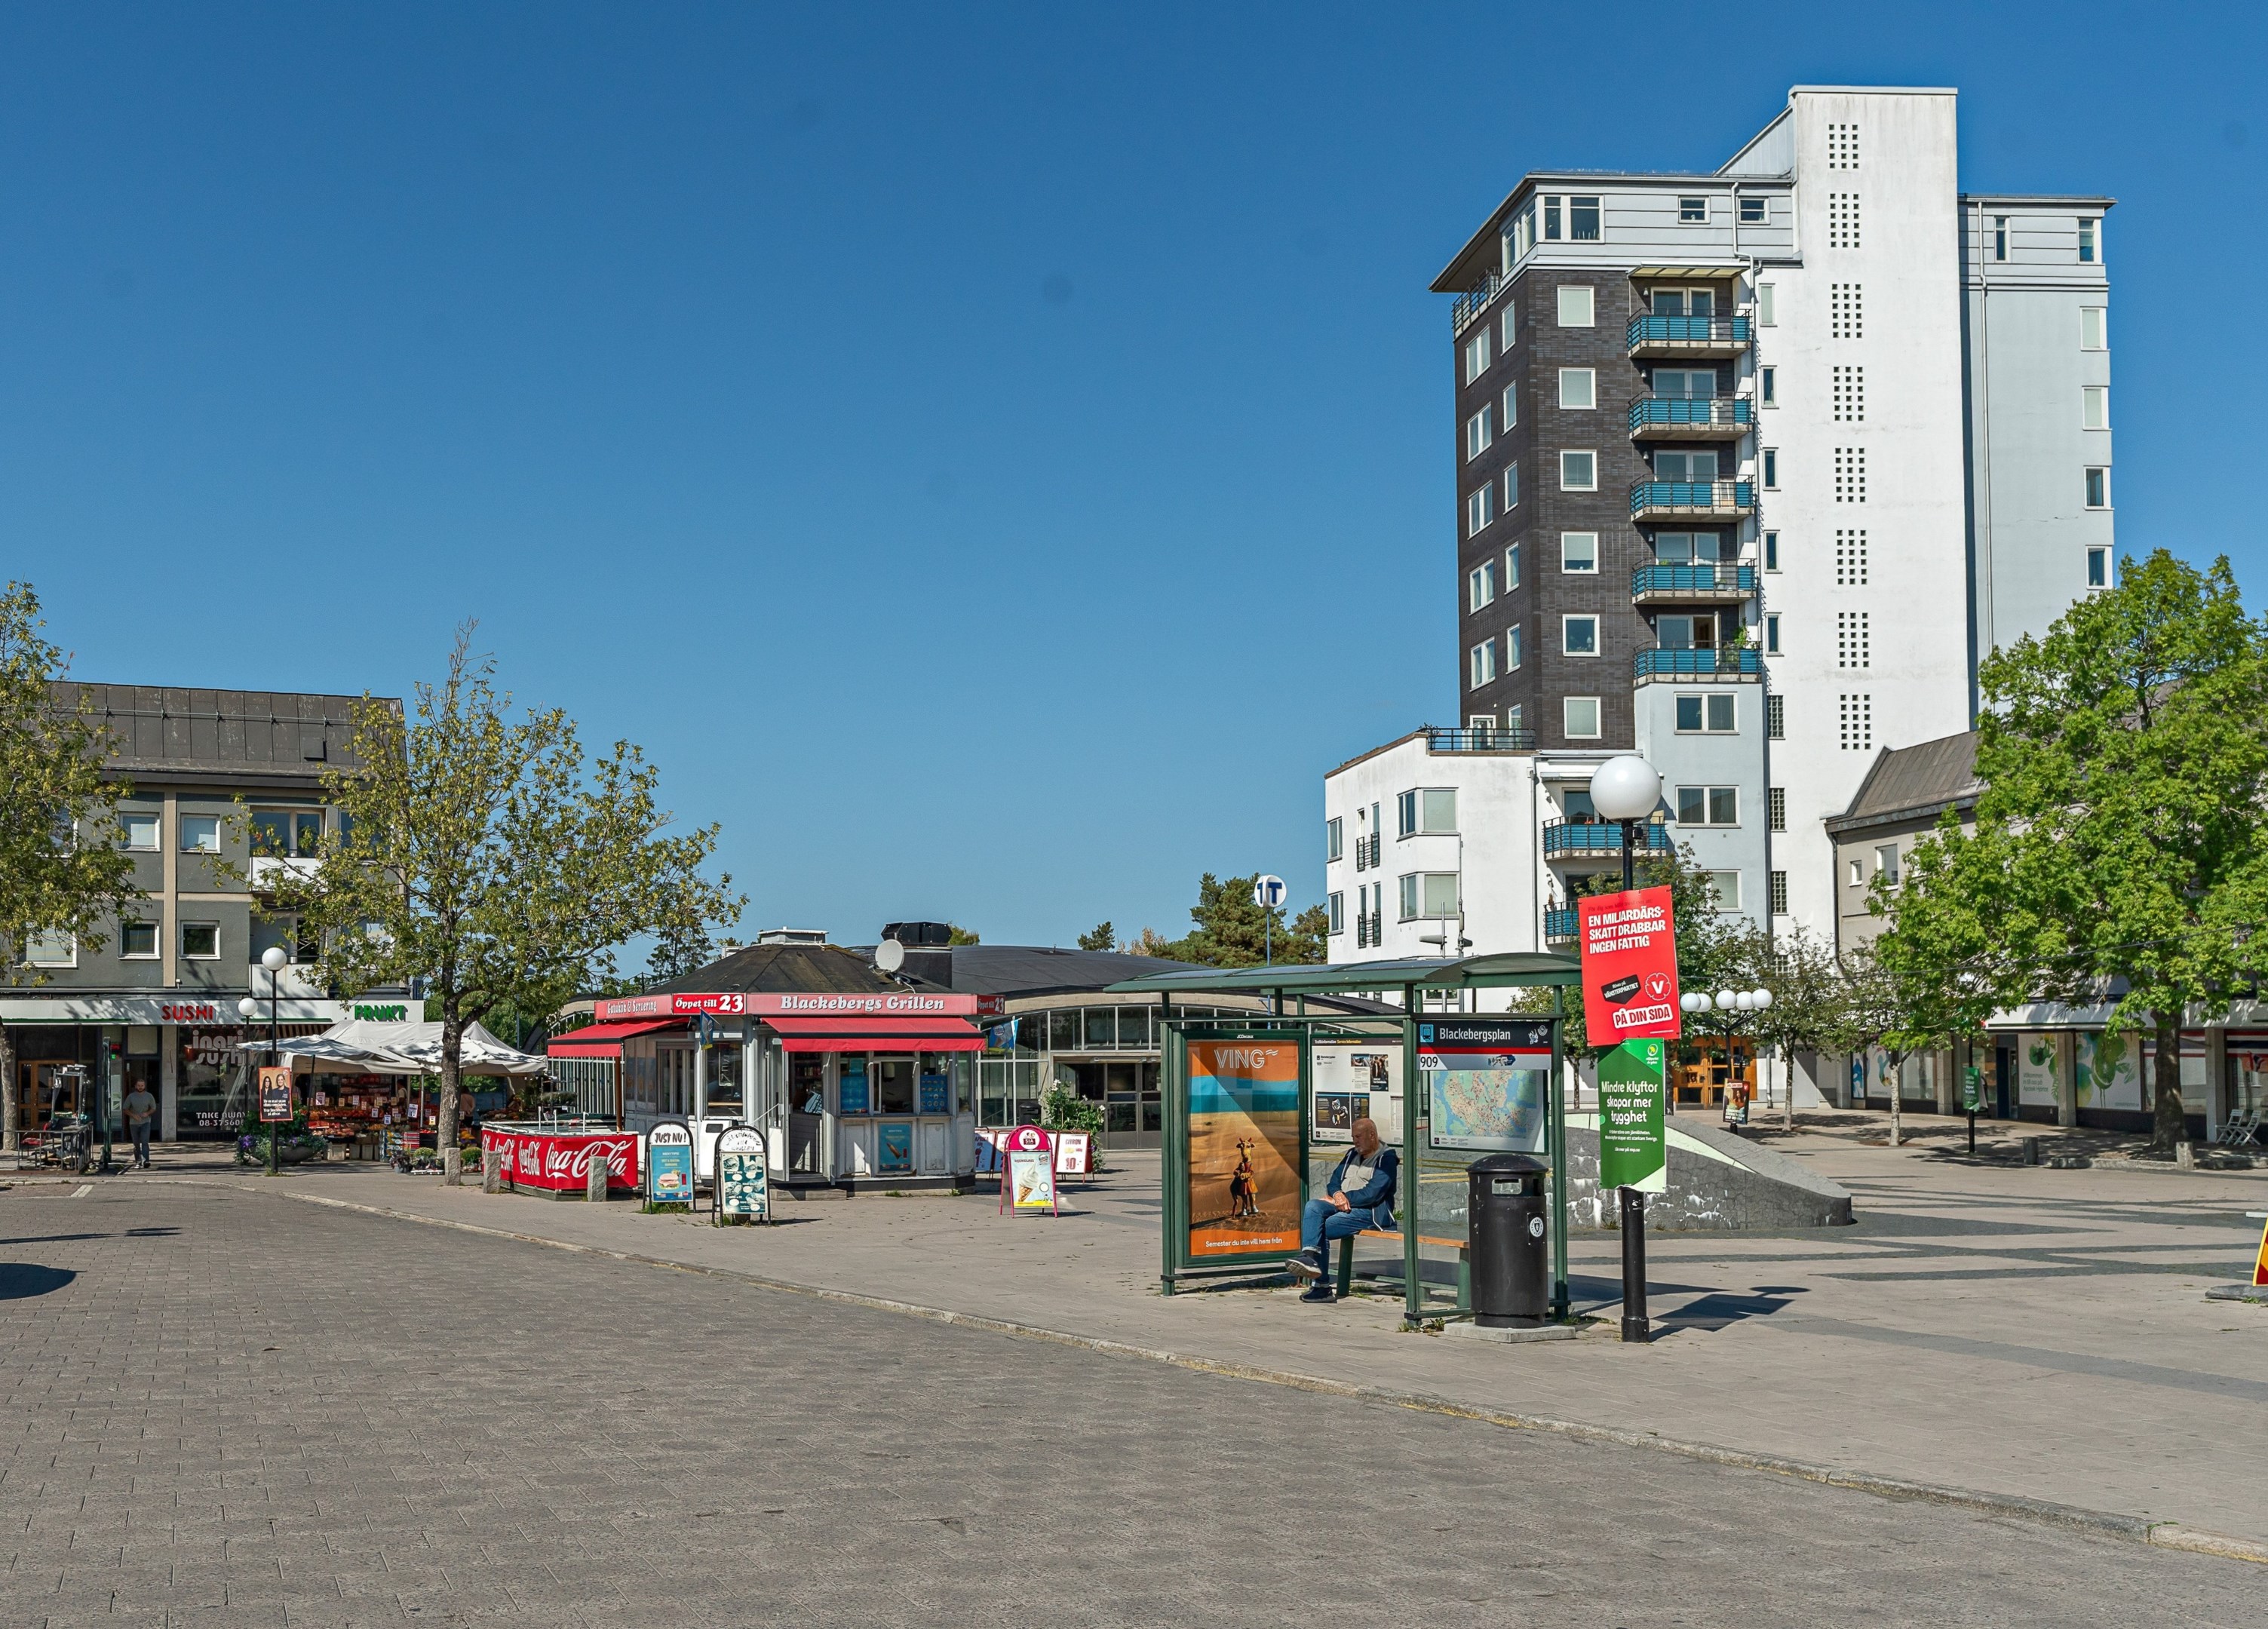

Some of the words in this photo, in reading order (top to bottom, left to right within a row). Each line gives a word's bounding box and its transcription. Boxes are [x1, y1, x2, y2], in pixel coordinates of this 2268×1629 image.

[1268, 882, 1282, 903] T
[1588, 914, 1601, 927] EN
[1602, 906, 1665, 925] MILJARDÄRS-
[1588, 925, 1618, 941] SKATT
[1618, 919, 1666, 937] DRABBAR
[1589, 940, 1617, 955] INGEN
[1617, 934, 1650, 950] FATTIG
[1604, 982, 1639, 999] VÄNSTERPARTIET
[1651, 980, 1665, 994] V
[607, 1002, 627, 1014] Gatukök
[627, 1000, 632, 1012] &
[632, 999, 657, 1013] Servering
[675, 997, 702, 1009] Öppet
[704, 997, 717, 1007] till
[719, 995, 744, 1012] 23
[781, 996, 882, 1011] Blackebergs
[886, 996, 945, 1010] Grillen
[994, 997, 1005, 1014] 23
[161, 1005, 213, 1020] SUSHI
[354, 1005, 406, 1020] FRUKT
[1615, 1011, 1628, 1026] PÅ
[1628, 1010, 1647, 1023] DIN
[1648, 1006, 1671, 1020] SIDA
[192, 1029, 244, 1049] inari
[1439, 1028, 1511, 1042] Blackebergsplan
[1214, 1049, 1265, 1069] VING
[1420, 1056, 1439, 1068] 909
[1601, 1081, 1625, 1093] Mindre
[1626, 1081, 1658, 1096] klyftor
[1607, 1095, 1632, 1110] skapar
[1633, 1098, 1652, 1107] mer
[1610, 1110, 1647, 1125] trygghet
[655, 1133, 671, 1143] JUST
[545, 1140, 634, 1180] Coca-Cla
